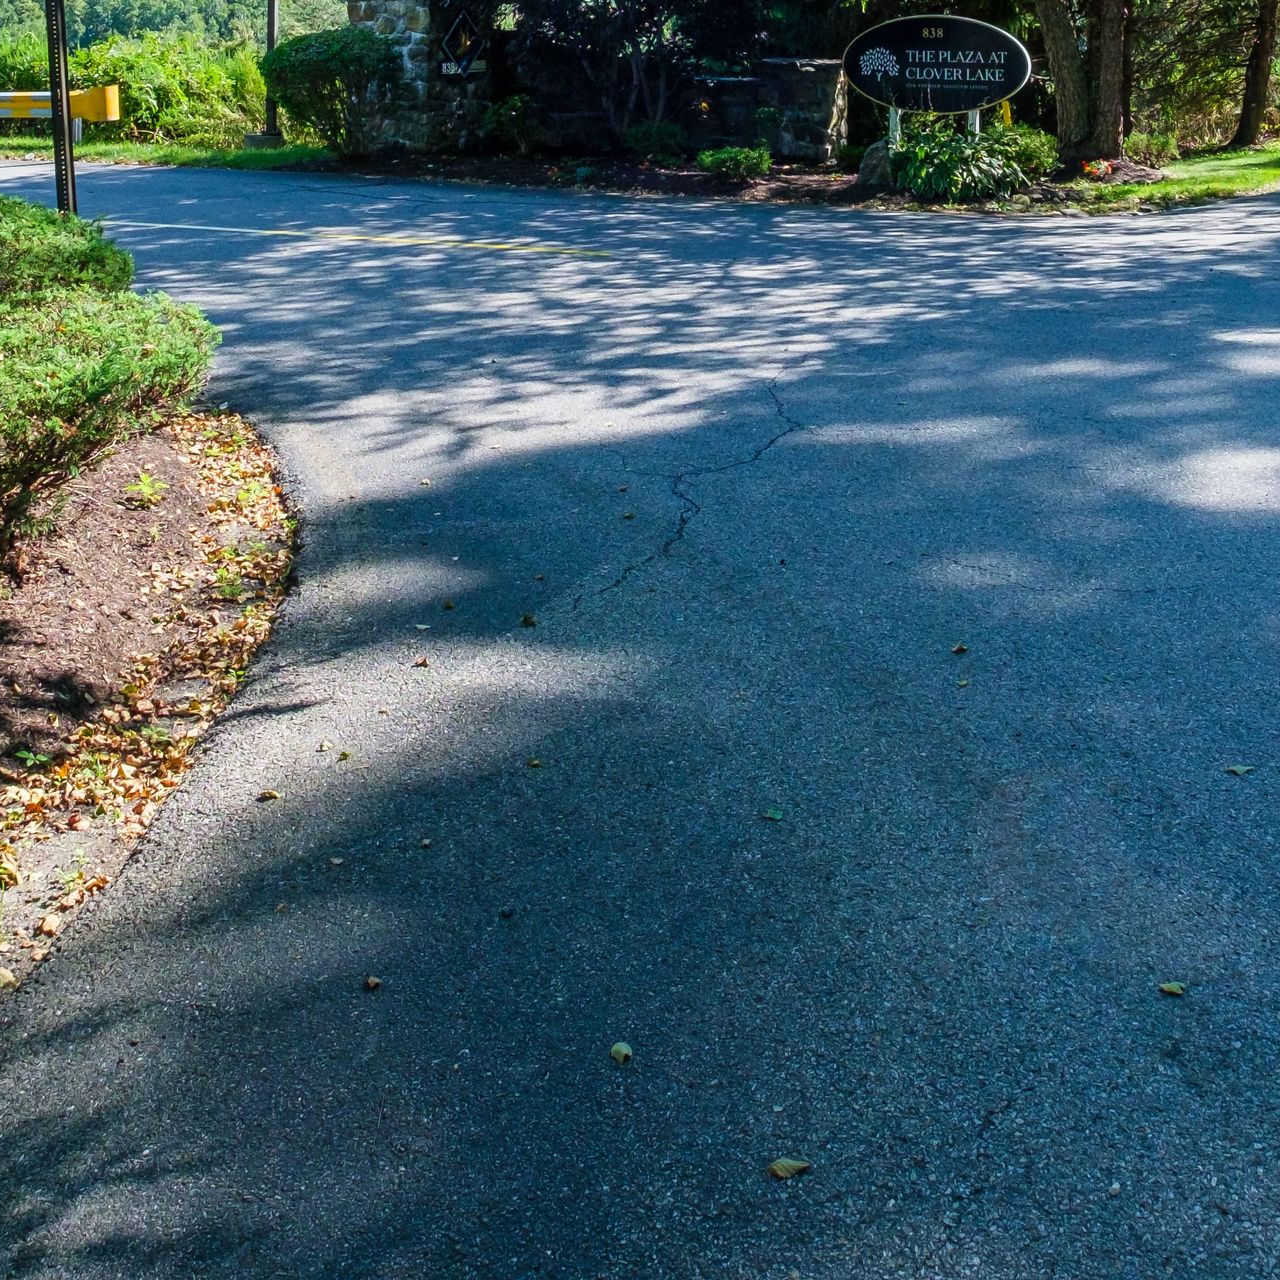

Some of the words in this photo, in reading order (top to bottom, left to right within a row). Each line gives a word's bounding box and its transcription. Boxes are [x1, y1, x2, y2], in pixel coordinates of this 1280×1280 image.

[922, 28, 944, 38] 838
[905, 50, 936, 63] THE
[938, 50, 985, 64] PLAZA
[988, 51, 1008, 64] AT
[906, 67, 962, 81] CLOVER
[966, 68, 1005, 81] LAKE
